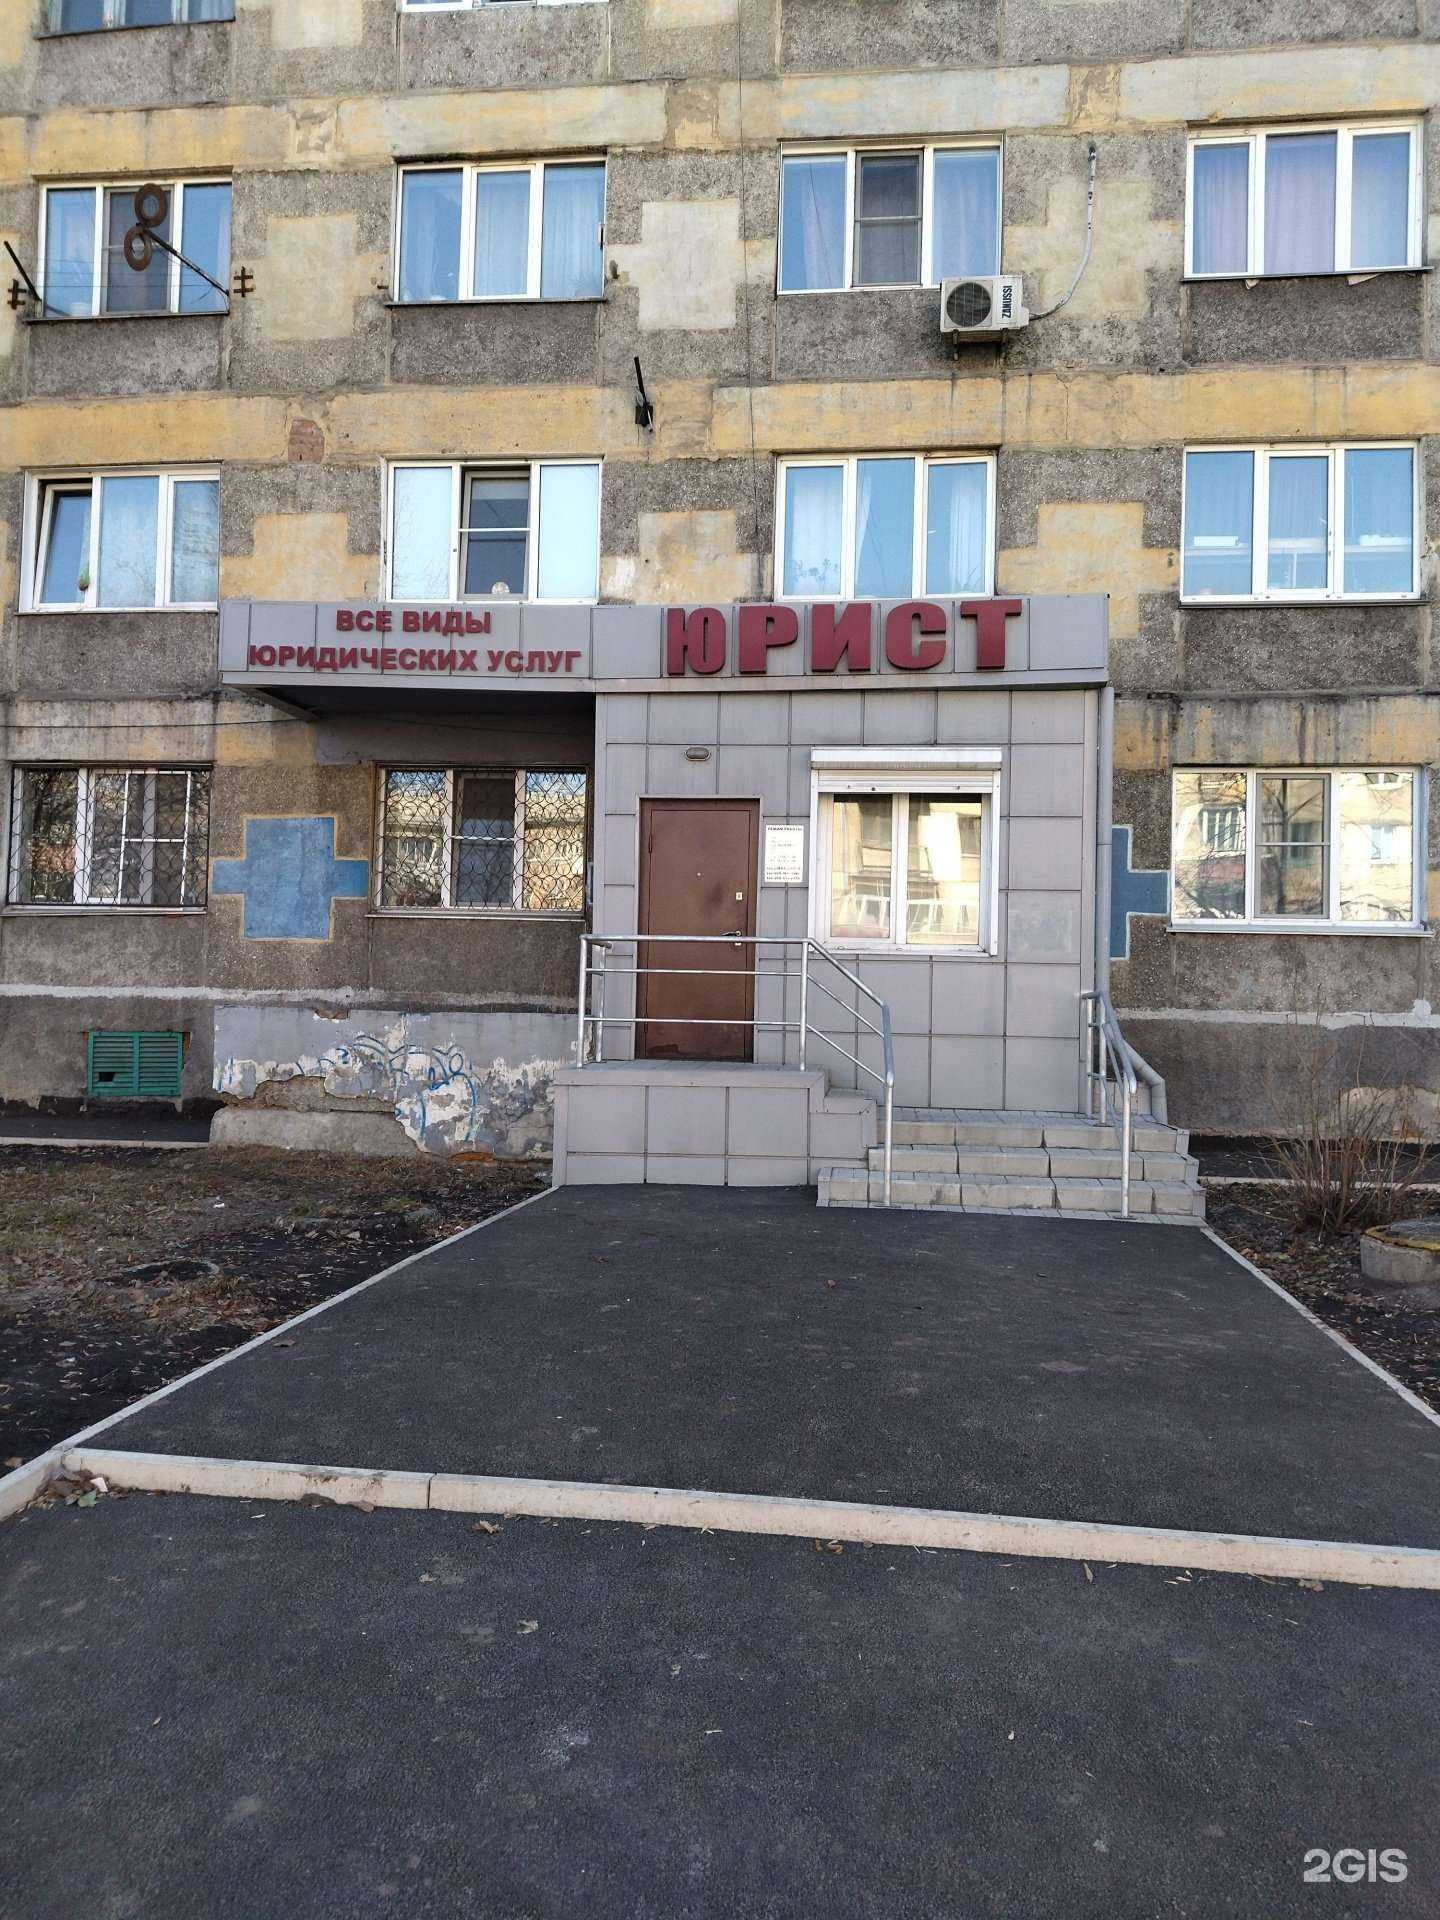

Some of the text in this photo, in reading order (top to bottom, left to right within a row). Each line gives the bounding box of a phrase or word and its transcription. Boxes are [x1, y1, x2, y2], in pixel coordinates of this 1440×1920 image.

[1002, 285, 1013, 319] ZANUSSI
[335, 609, 492, 637] ВСЕ ВИДЫ
[666, 599, 1022, 676] ЮРИСТ
[248, 645, 582, 673] ЮРИДИЧЕСКИХ УСЛУГ
